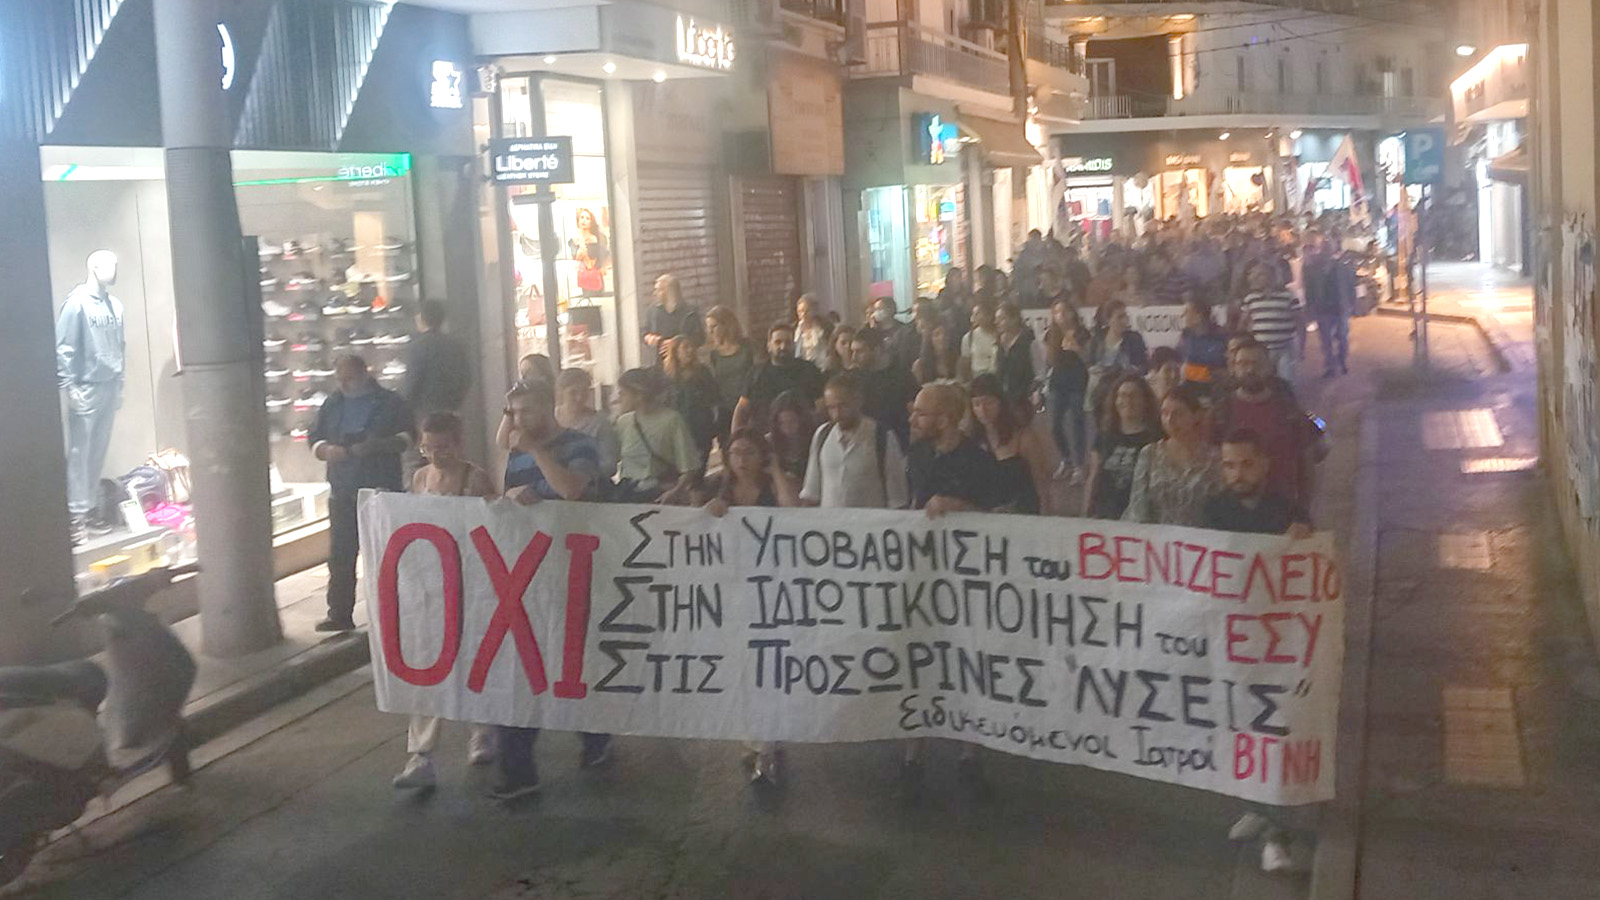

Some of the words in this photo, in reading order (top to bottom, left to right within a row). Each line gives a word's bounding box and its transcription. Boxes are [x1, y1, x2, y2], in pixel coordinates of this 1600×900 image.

[495, 153, 559, 172] Liberté
[1411, 132, 1433, 160] P
[622, 510, 724, 569] ΣΤΗΝ
[741, 515, 1009, 576] ΥΠΟΒΑΘΜΙΣΗ
[1022, 556, 1071, 581] του
[1078, 532, 1342, 604] ΒΕΝΙΖΕΛΕΙΟ
[378, 522, 600, 699] ΟΧΙ
[598, 575, 723, 634] ΣΤΗΝ
[746, 575, 1143, 648] ΙΔΙΩΤΙΚΟΠΟΙΗΣΗ
[1155, 631, 1208, 657] του
[1225, 611, 1322, 667] ΕΣΥ
[593, 640, 725, 694] ΣΤΙΣ
[747, 637, 1049, 708] ΠΡΟΣΩΡΙΝΕΣ
[1129, 725, 1218, 775] Ιατροί
[1233, 732, 1321, 787] ΒΓΝΗ
